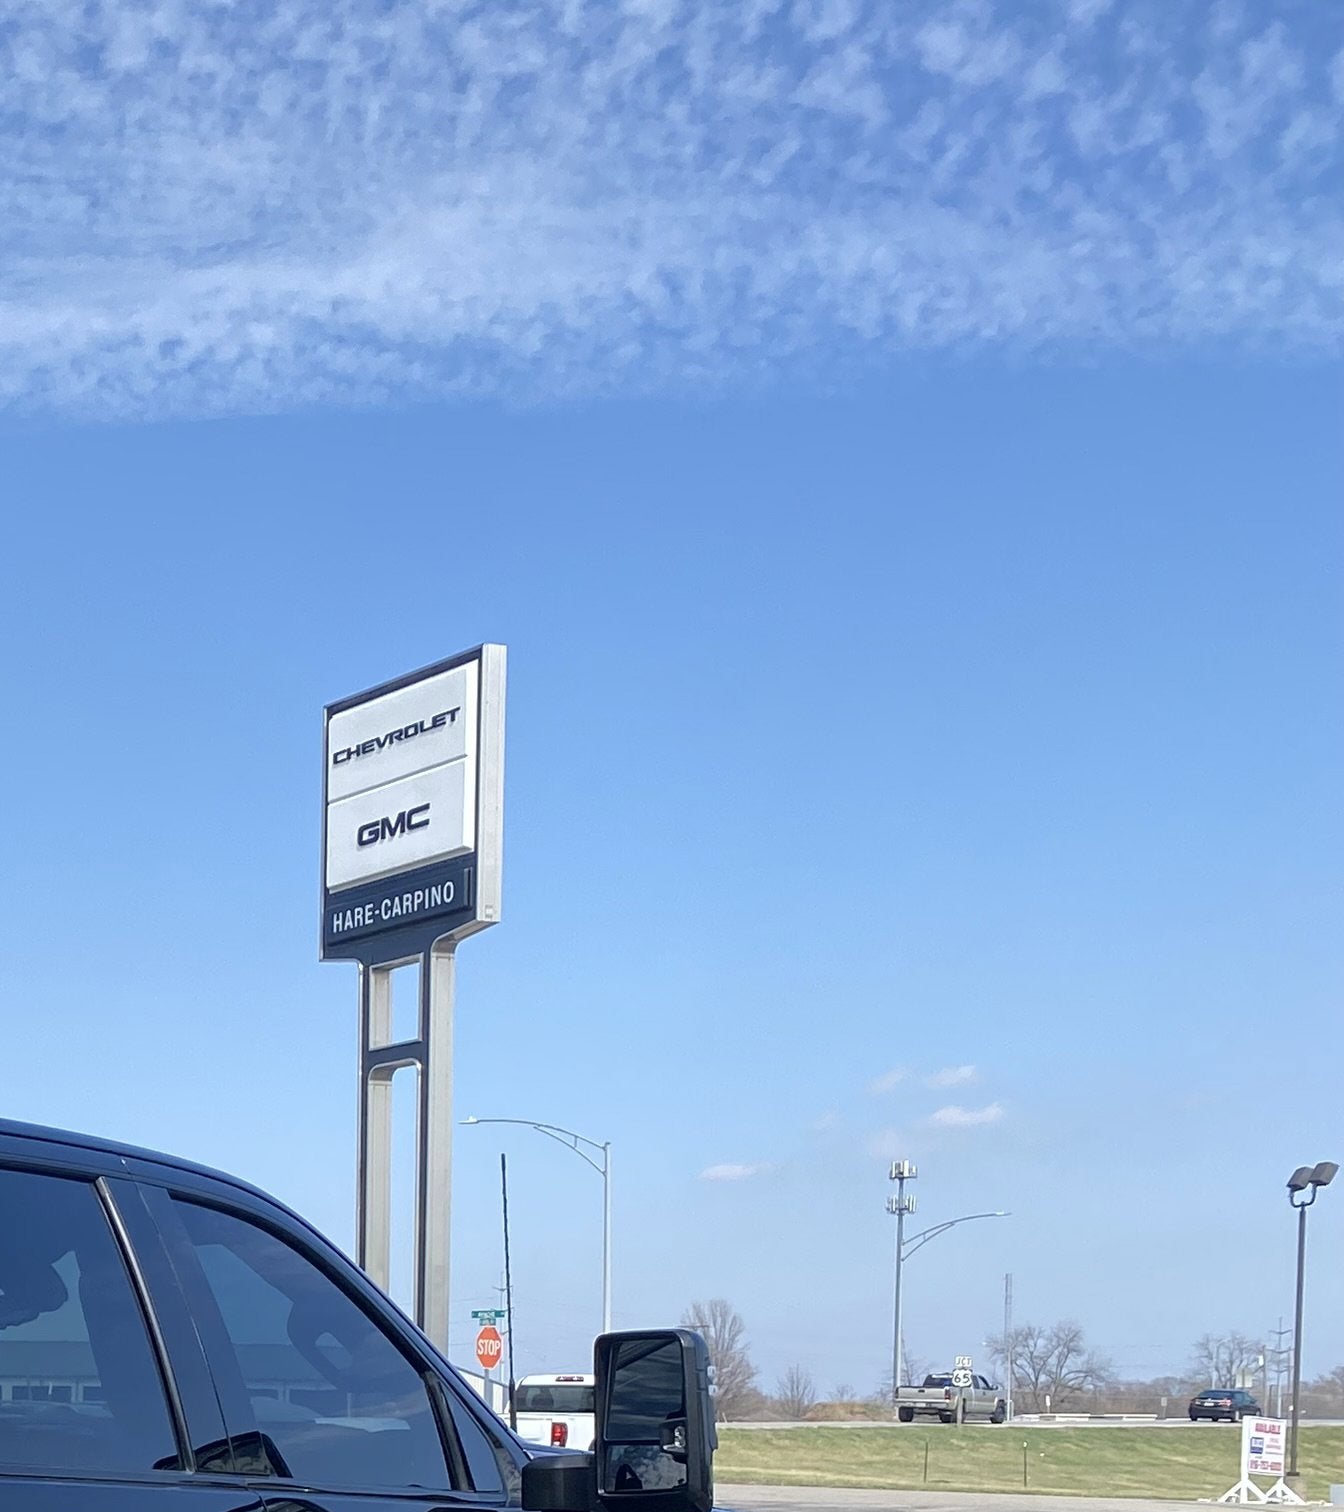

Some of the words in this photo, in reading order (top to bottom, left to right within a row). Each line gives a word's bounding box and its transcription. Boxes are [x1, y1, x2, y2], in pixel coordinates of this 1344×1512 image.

[332, 706, 461, 766] CHEVROLET
[357, 803, 430, 847] GMC
[332, 880, 455, 934] HARE-CARPINO
[477, 1338, 501, 1356] STOP
[956, 1357, 971, 1366] JCT
[954, 1373, 970, 1384] 65
